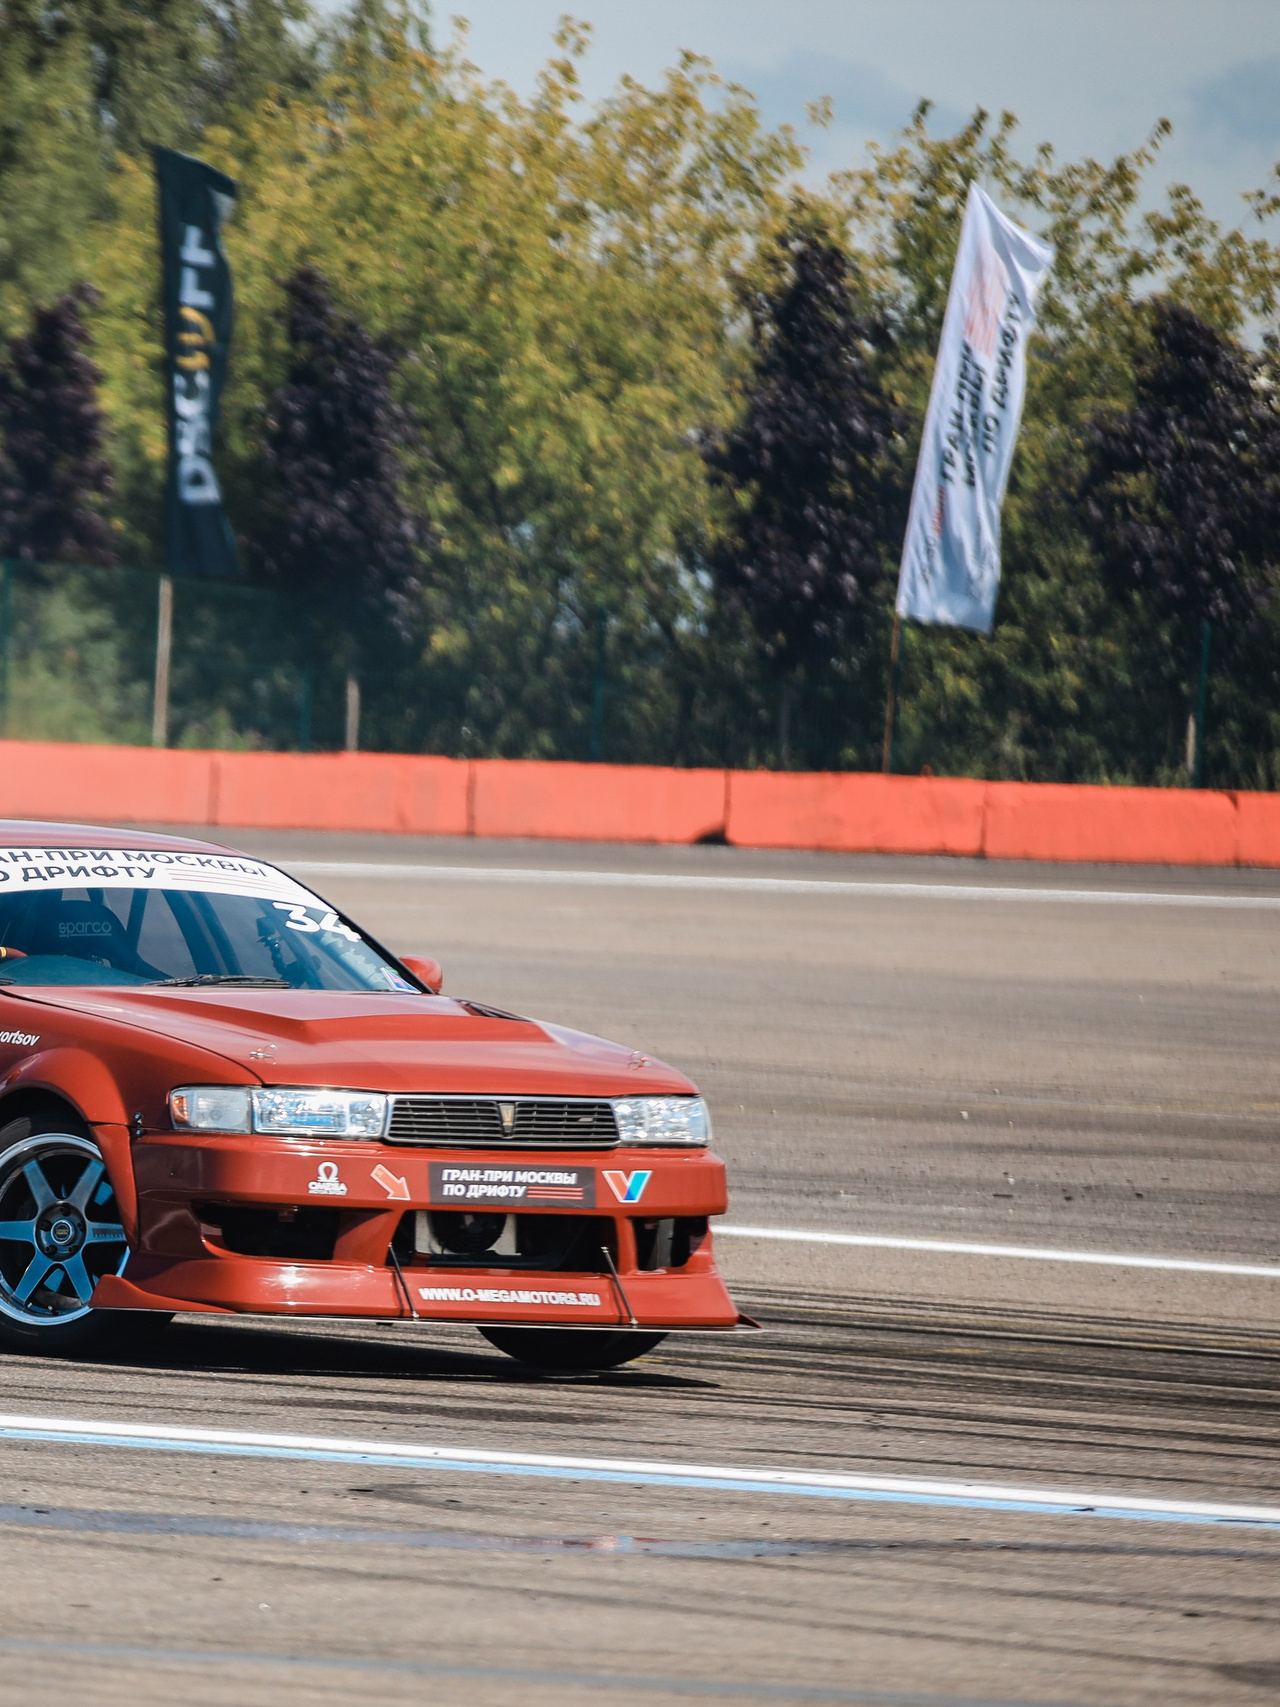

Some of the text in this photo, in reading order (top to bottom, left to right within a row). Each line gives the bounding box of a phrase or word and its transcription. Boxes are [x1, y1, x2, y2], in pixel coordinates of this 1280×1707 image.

[122, 851, 269, 877] МОСКВЫ
[22, 866, 157, 882] ДРИФТУ
[58, 921, 113, 938] sparco
[272, 902, 363, 943] 34
[441, 1169, 578, 1185] ГРАН-ПРИ МОСКВЫ
[442, 1184, 528, 1198] ПО ДРИФТУ
[418, 1288, 601, 1306] WWW.O-MEGAMOTORS.RU
